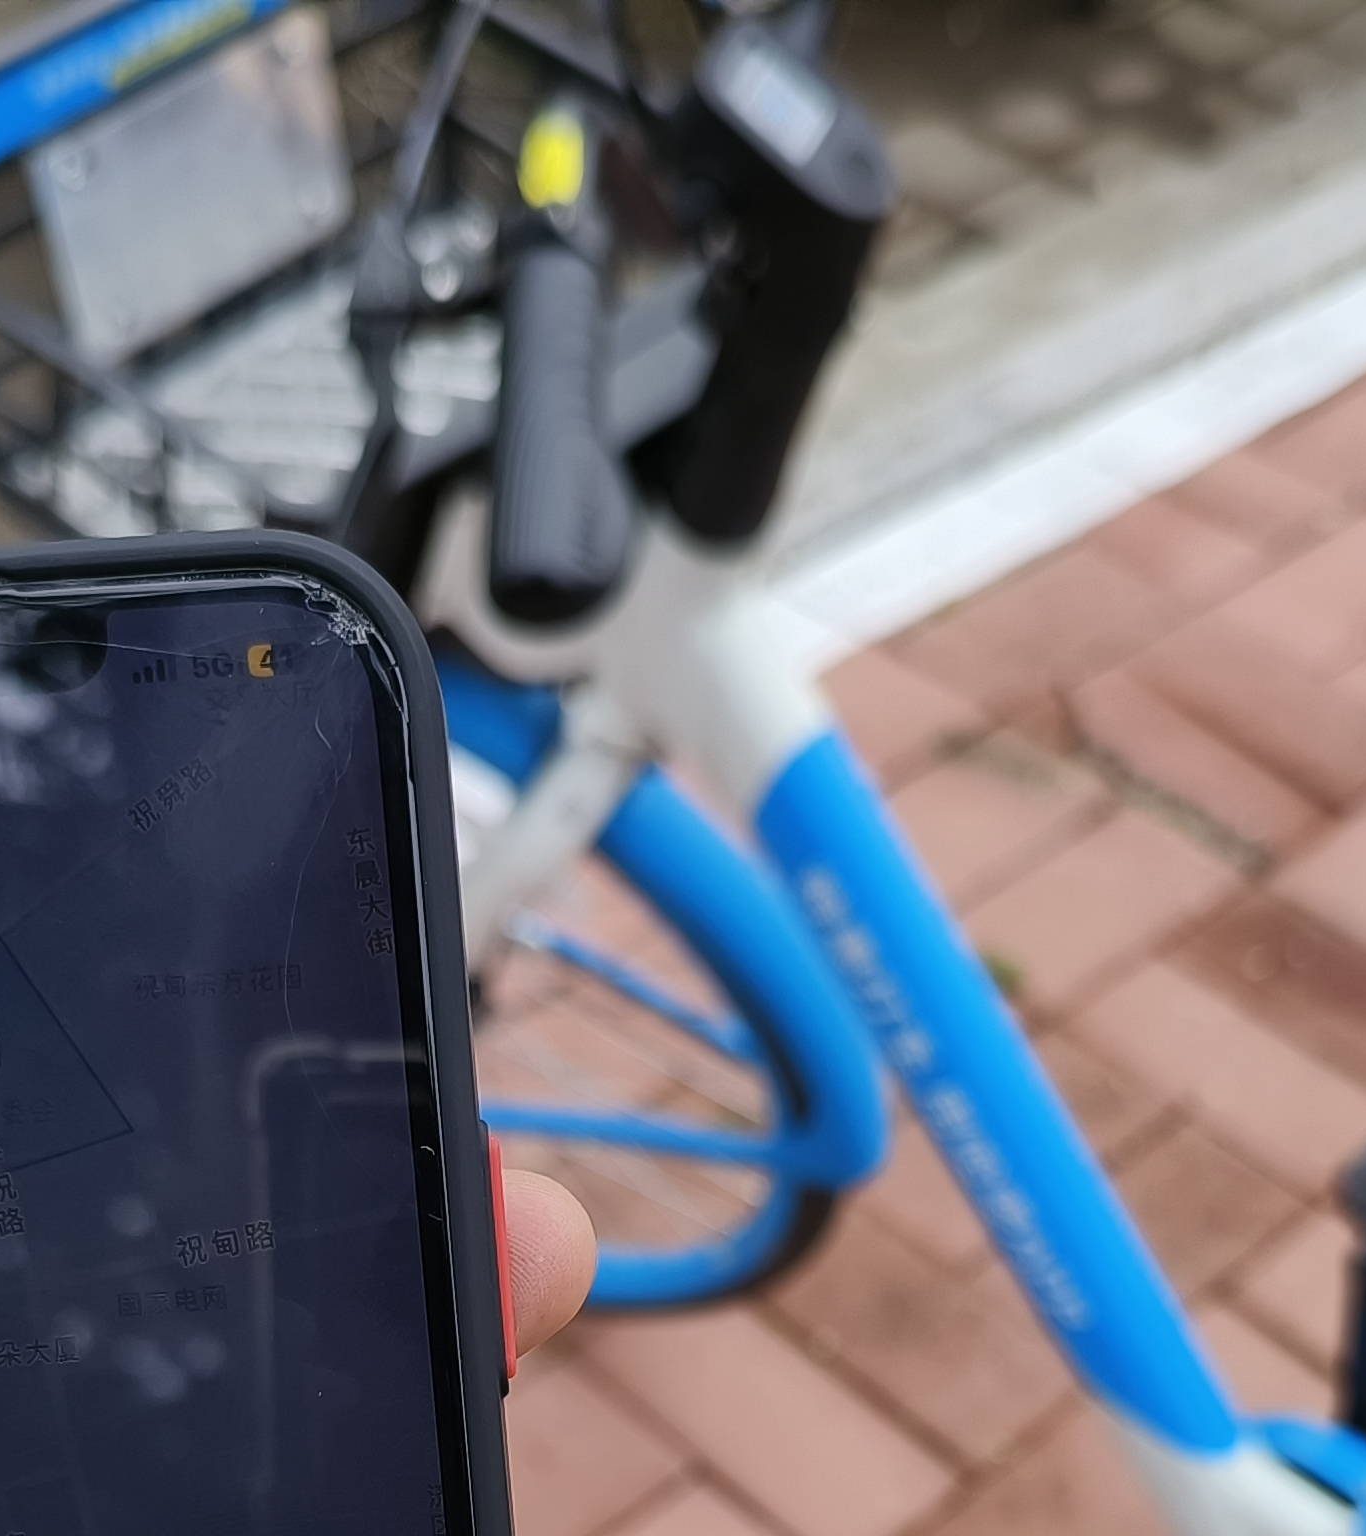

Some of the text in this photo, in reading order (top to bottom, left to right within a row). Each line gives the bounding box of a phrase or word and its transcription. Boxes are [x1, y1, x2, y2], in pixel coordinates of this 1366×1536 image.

[193, 653, 233, 678] 5G
[126, 759, 212, 831] 祝舜路
[176, 1220, 276, 1267] 祝甸路
[118, 1285, 228, 1316] 国家电网
